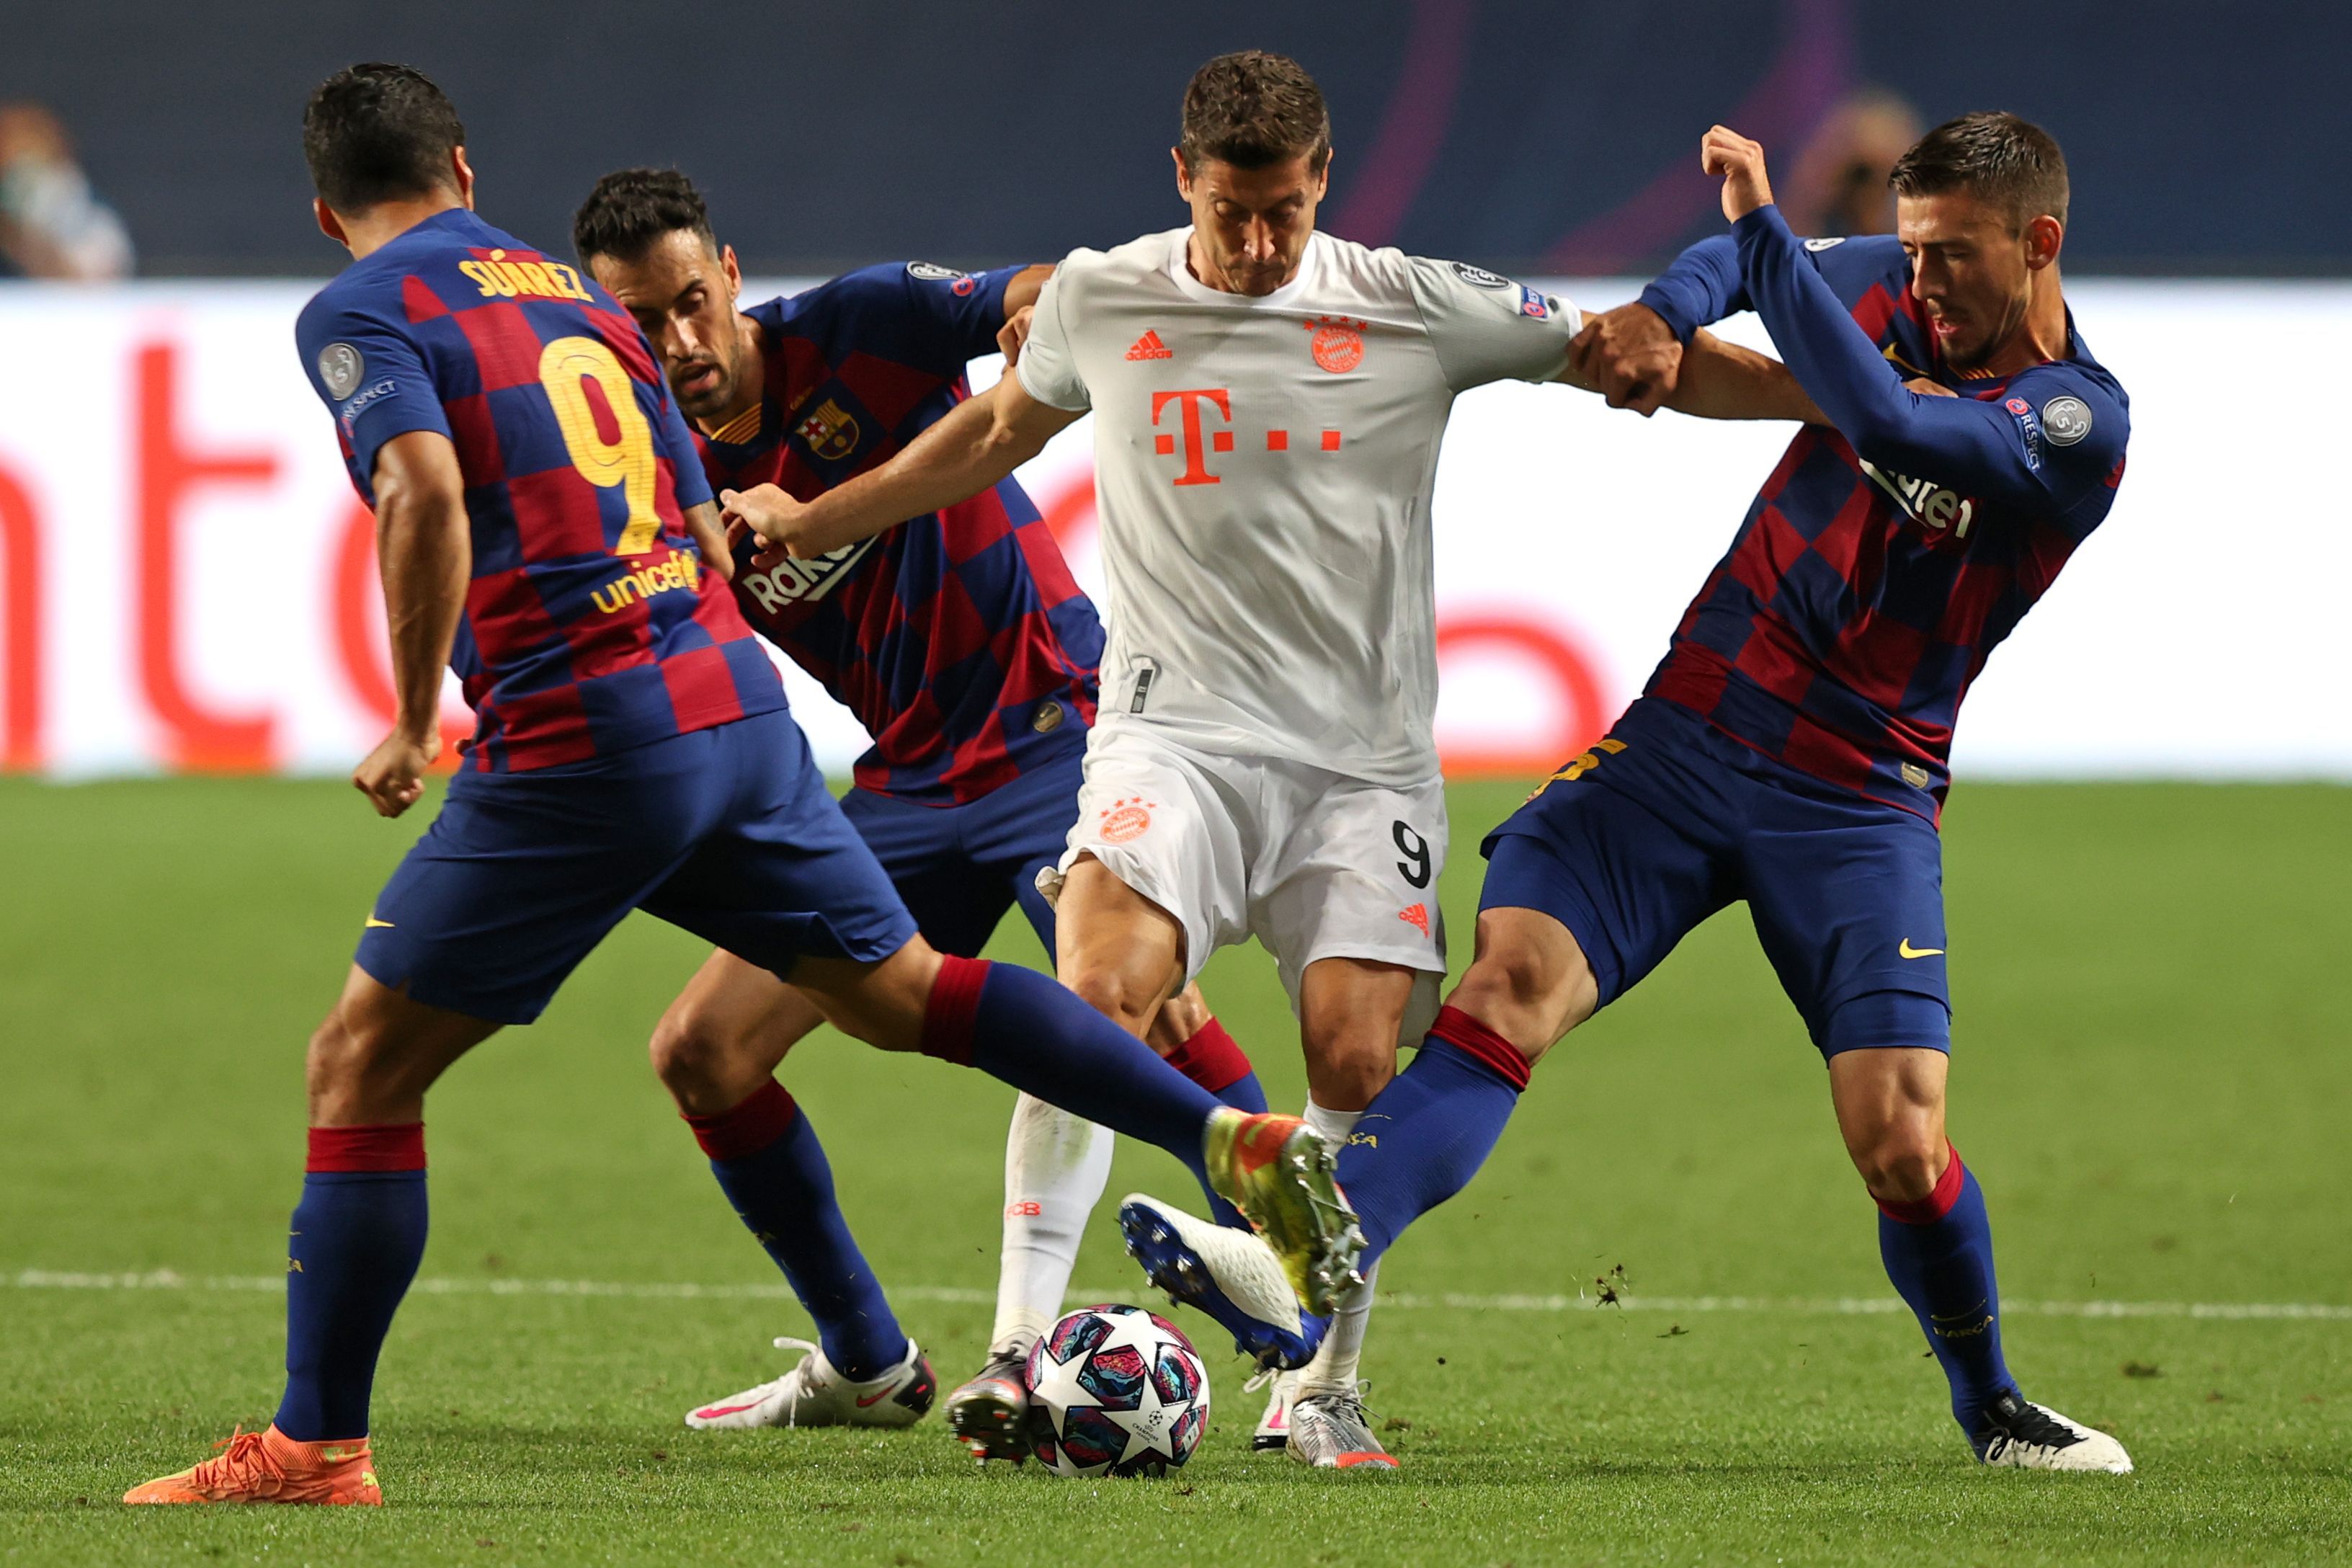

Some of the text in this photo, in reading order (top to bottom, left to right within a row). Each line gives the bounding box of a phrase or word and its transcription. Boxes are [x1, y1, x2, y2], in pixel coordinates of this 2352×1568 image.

[1125, 349, 1172, 361] adidas
[538, 337, 662, 556] 9
[1152, 389, 1231, 486] T
[2021, 414, 2040, 471] RESPECT
[2056, 416, 2071, 429] 5
[590, 550, 687, 614] unicef
[1392, 820, 1431, 889] 9
[1132, 1422, 1159, 1442] CHAMPIONS
